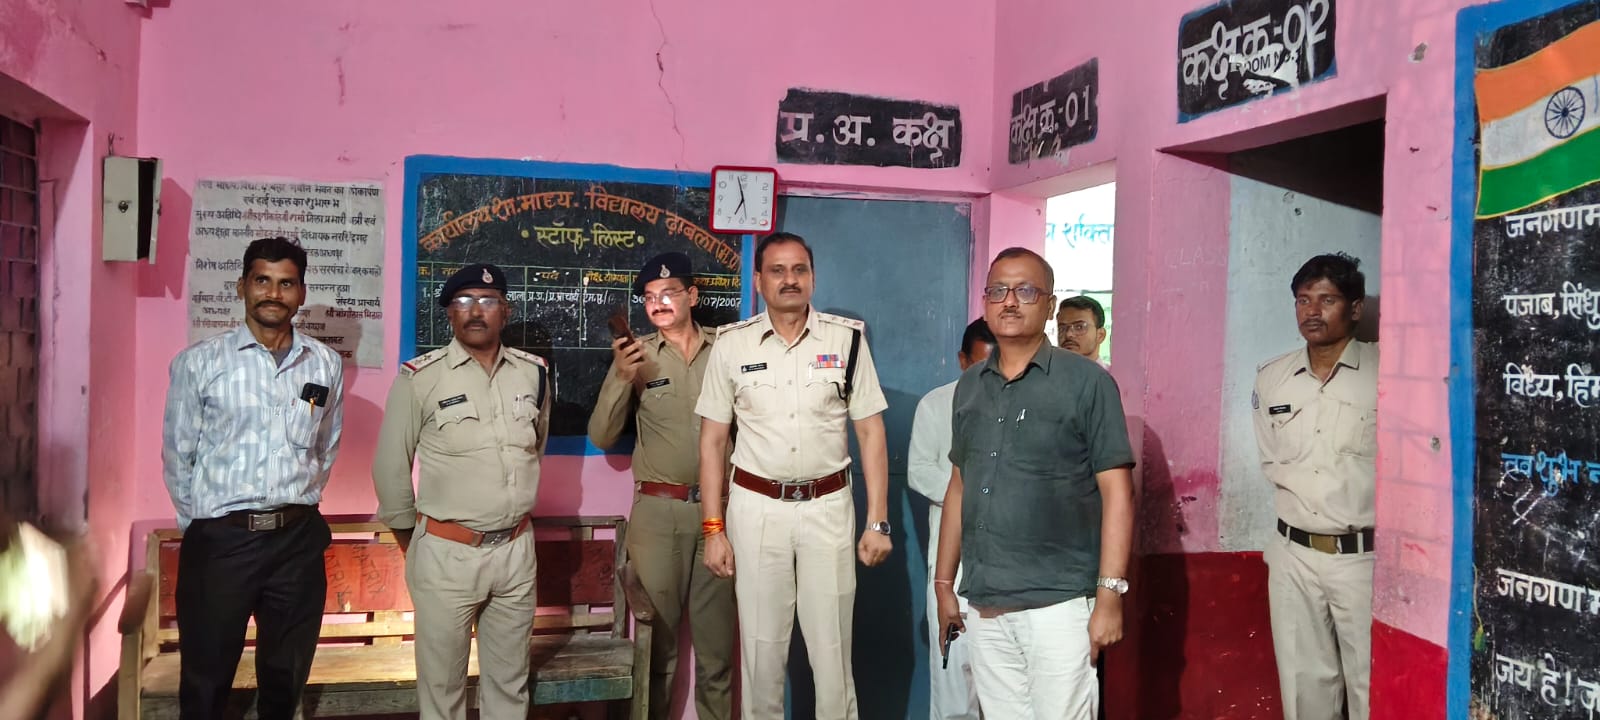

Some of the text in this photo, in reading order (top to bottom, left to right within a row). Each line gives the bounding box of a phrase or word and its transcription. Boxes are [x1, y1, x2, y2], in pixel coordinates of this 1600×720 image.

[892, 112, 955, 163] कक्ष
[584, 184, 665, 225] विद्यालय
[591, 222, 636, 250] लिस्ट
[1496, 653, 1535, 691] जय
